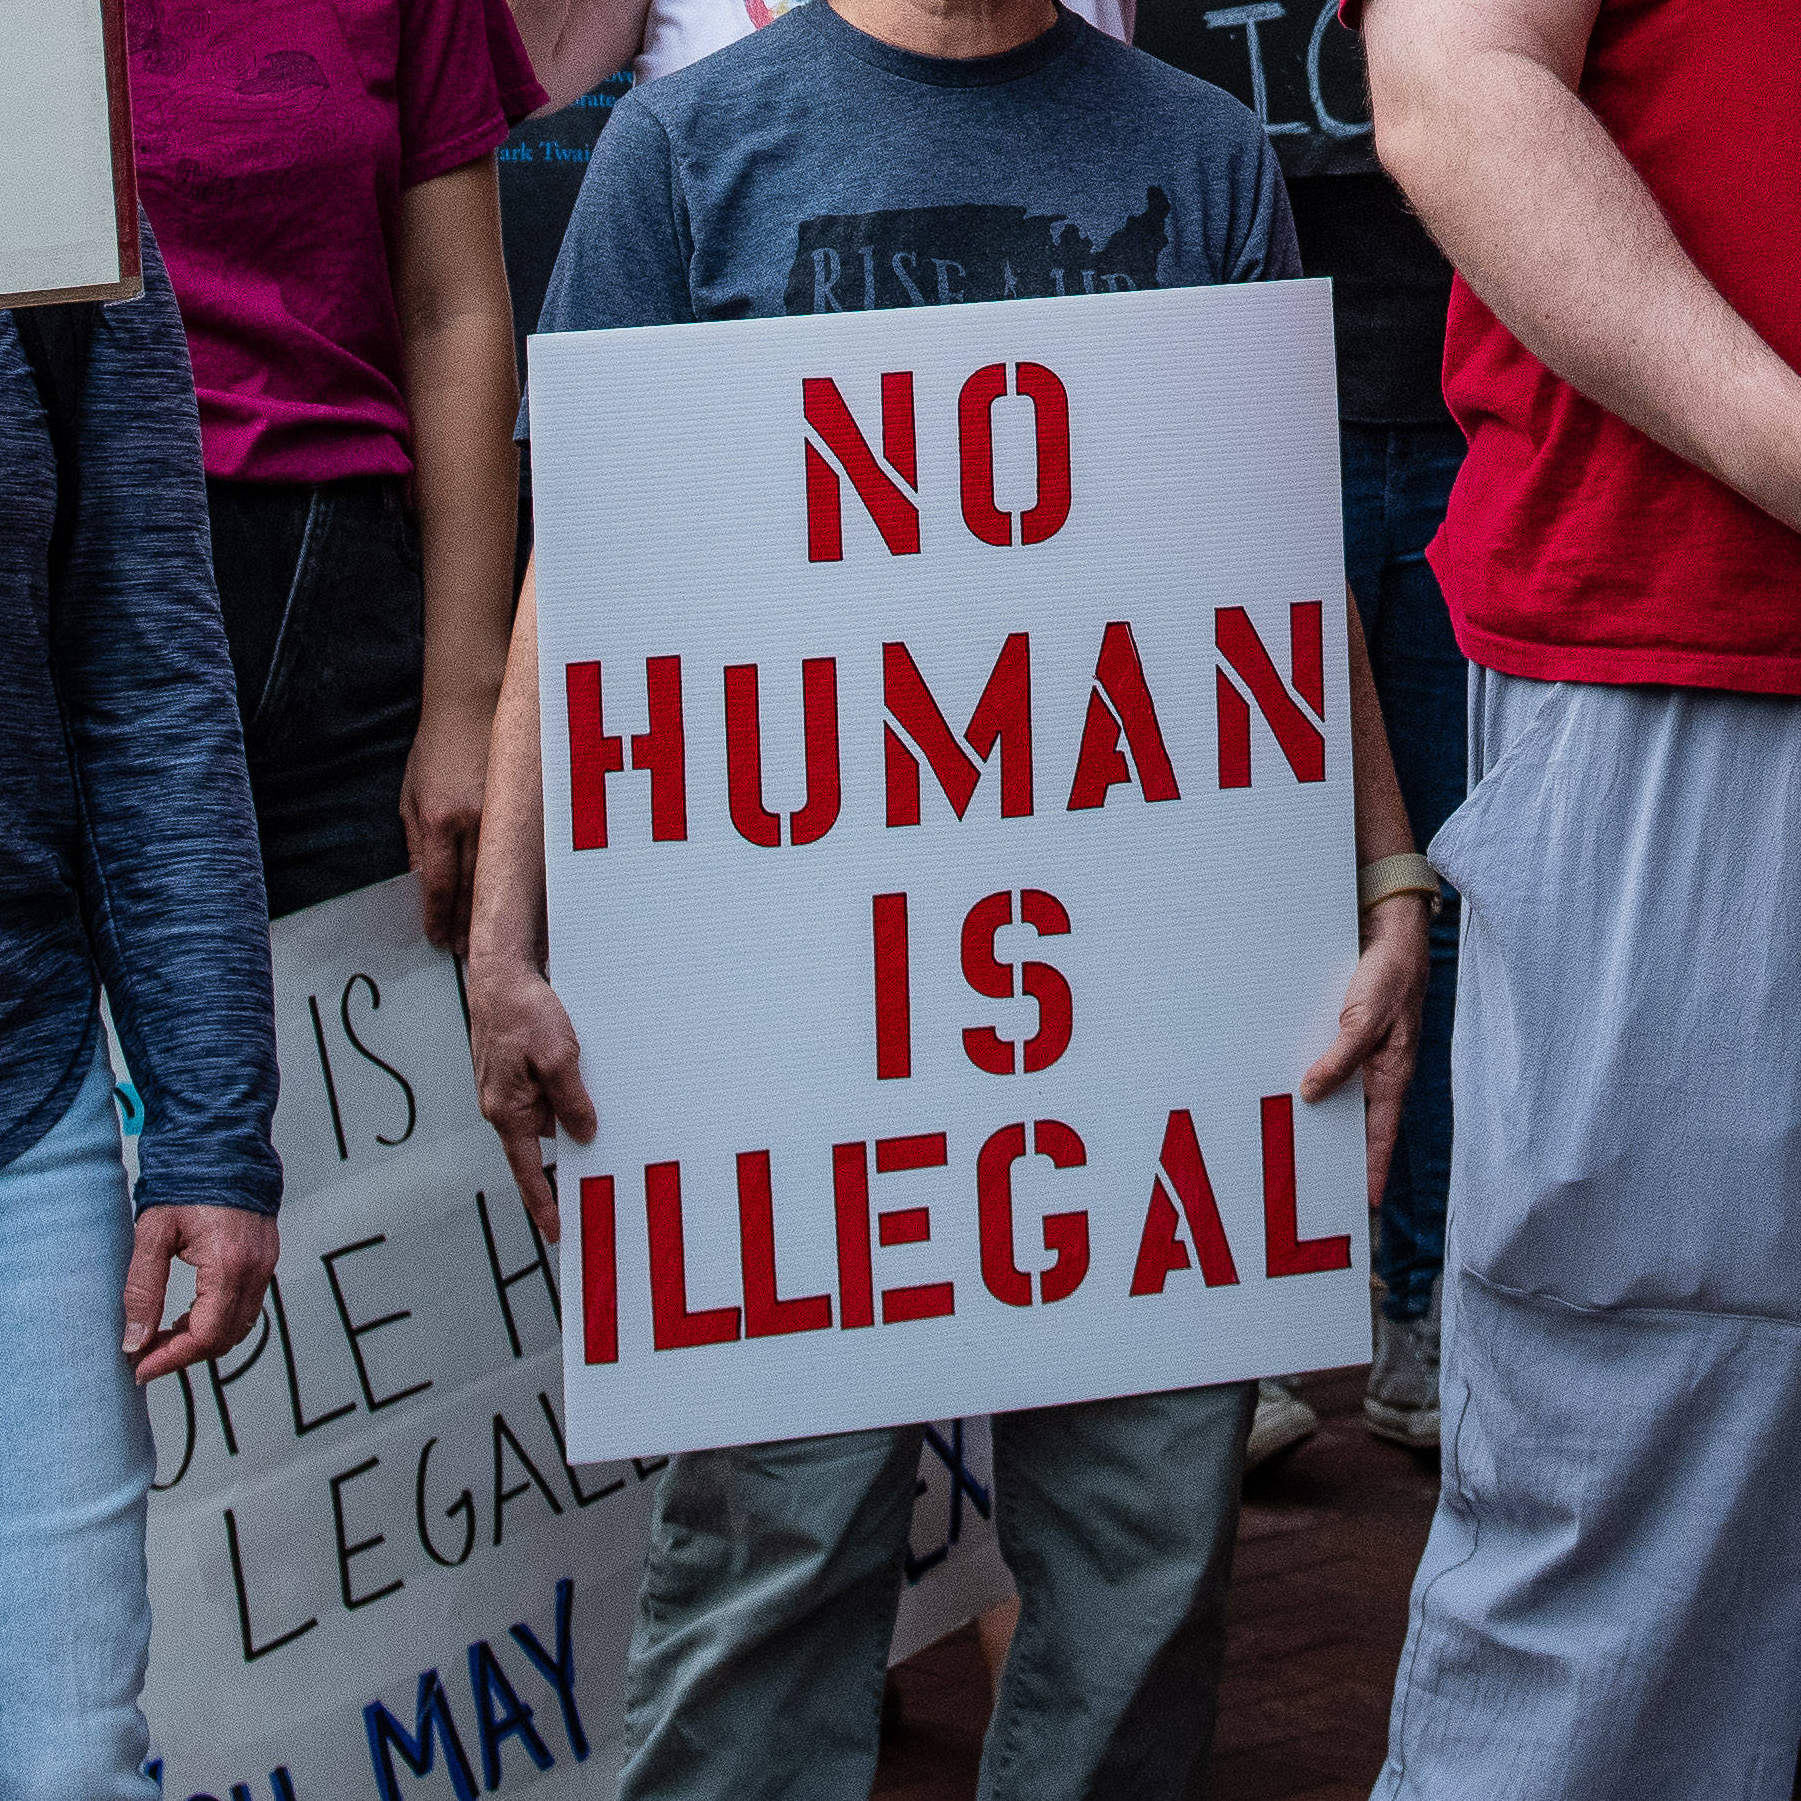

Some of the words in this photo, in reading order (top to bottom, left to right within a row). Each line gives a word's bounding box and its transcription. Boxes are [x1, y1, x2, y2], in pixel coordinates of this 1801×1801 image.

[499, 142, 534, 162] ark
[538, 140, 591, 163] Twai
[810, 245, 967, 314] RISE
[802, 359, 1072, 564] NO
[564, 599, 1327, 852] HUMAN
[308, 972, 417, 1161] IS
[870, 887, 1075, 1081] IS
[579, 1093, 1353, 1367] ILLEGAL
[151, 1233, 435, 1492] PLE
[224, 1390, 669, 1663] LEGAL
[361, 1576, 591, 1801] MAY
